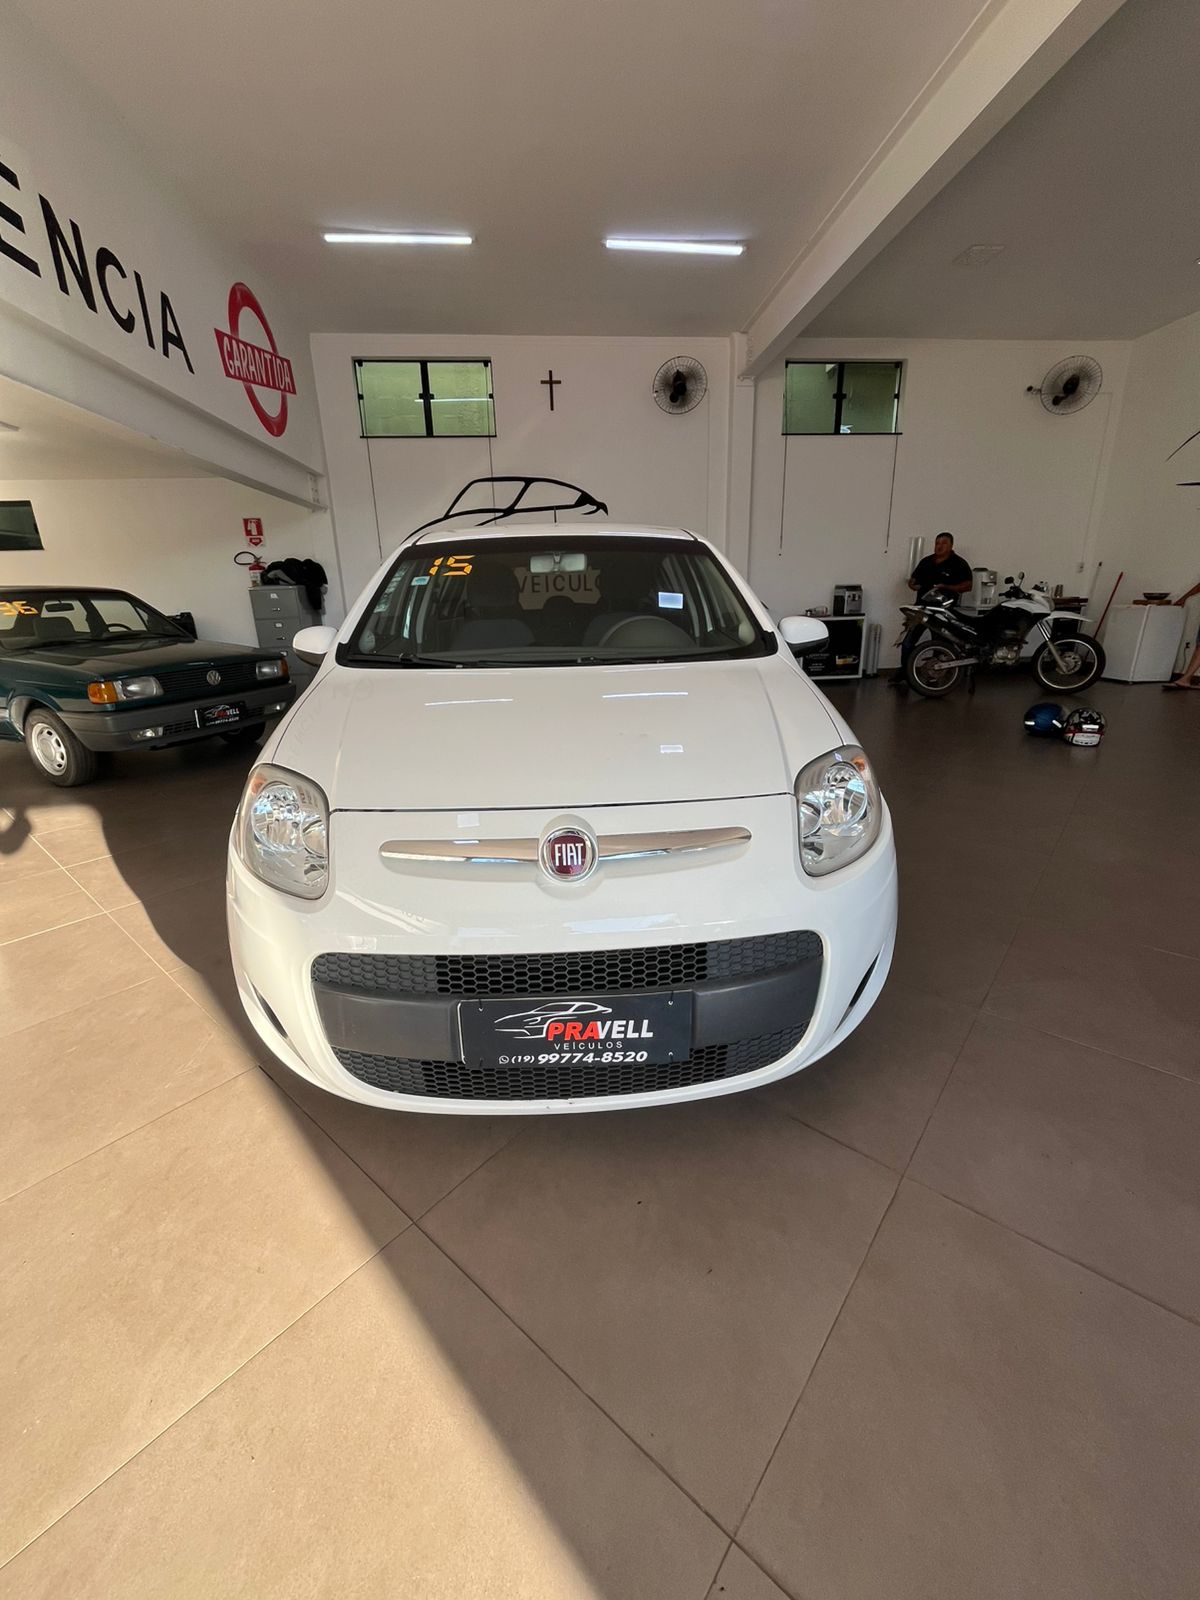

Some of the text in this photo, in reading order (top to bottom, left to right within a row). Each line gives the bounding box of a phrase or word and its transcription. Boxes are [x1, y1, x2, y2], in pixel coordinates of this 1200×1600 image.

[223, 335, 294, 393] GARANTIDA
[428, 554, 476, 577] 15
[554, 843, 584, 867] FIAT
[547, 1019, 654, 1041] PRAVELL
[511, 1051, 648, 1065] (19) 99774-8520
